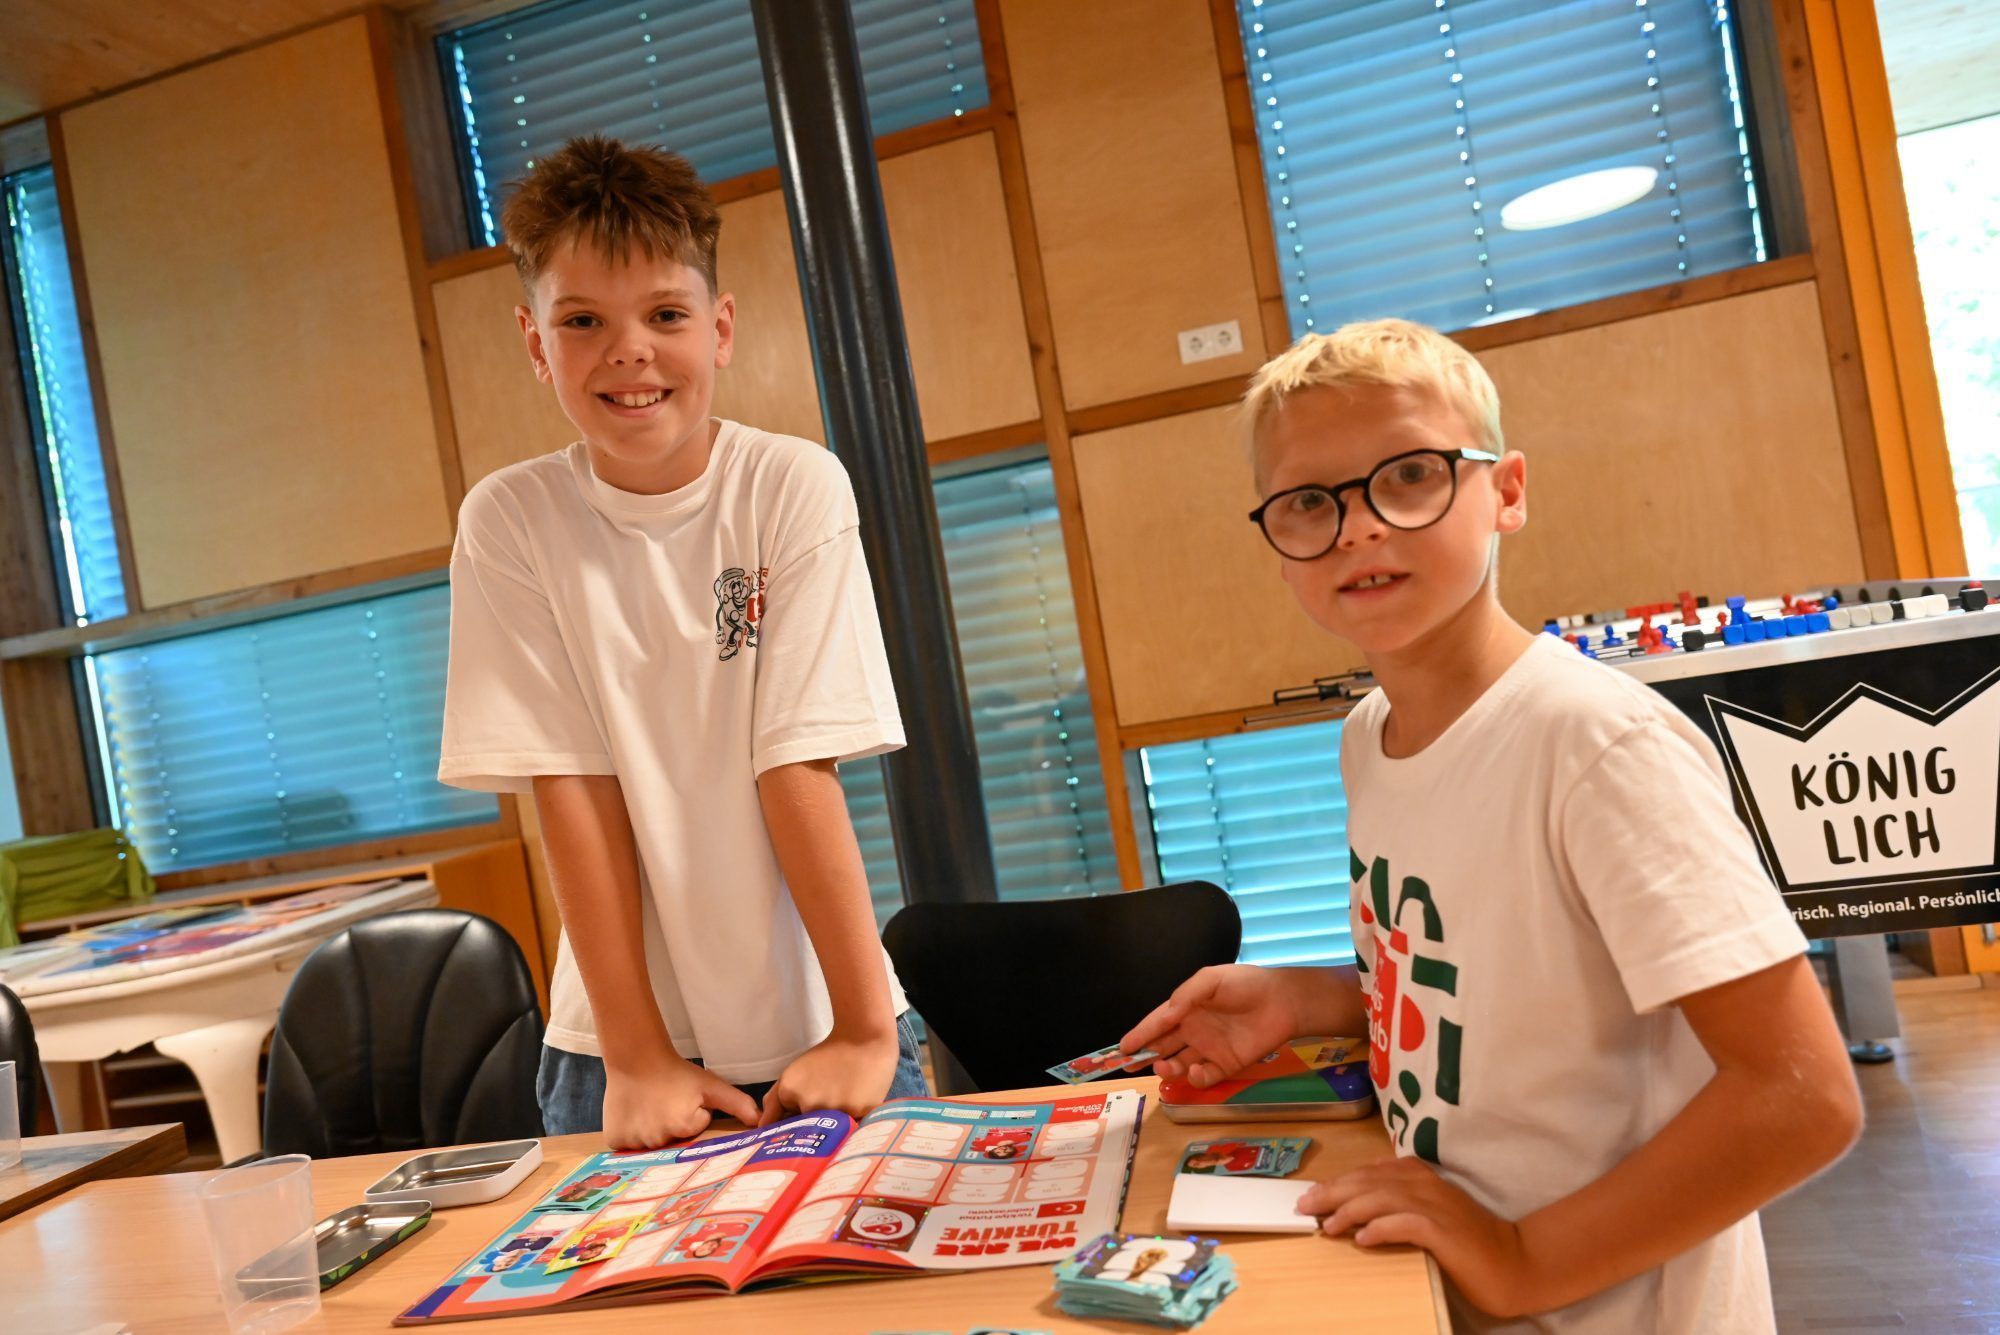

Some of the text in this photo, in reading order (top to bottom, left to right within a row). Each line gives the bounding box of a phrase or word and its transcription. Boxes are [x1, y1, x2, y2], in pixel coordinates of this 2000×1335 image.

[1791, 746, 1956, 811] KÖNIG
[1823, 807, 1941, 866] LICH
[1791, 904, 1835, 921] risch.
[1838, 897, 1915, 918] Regional.
[1016, 1236, 1077, 1253] WE
